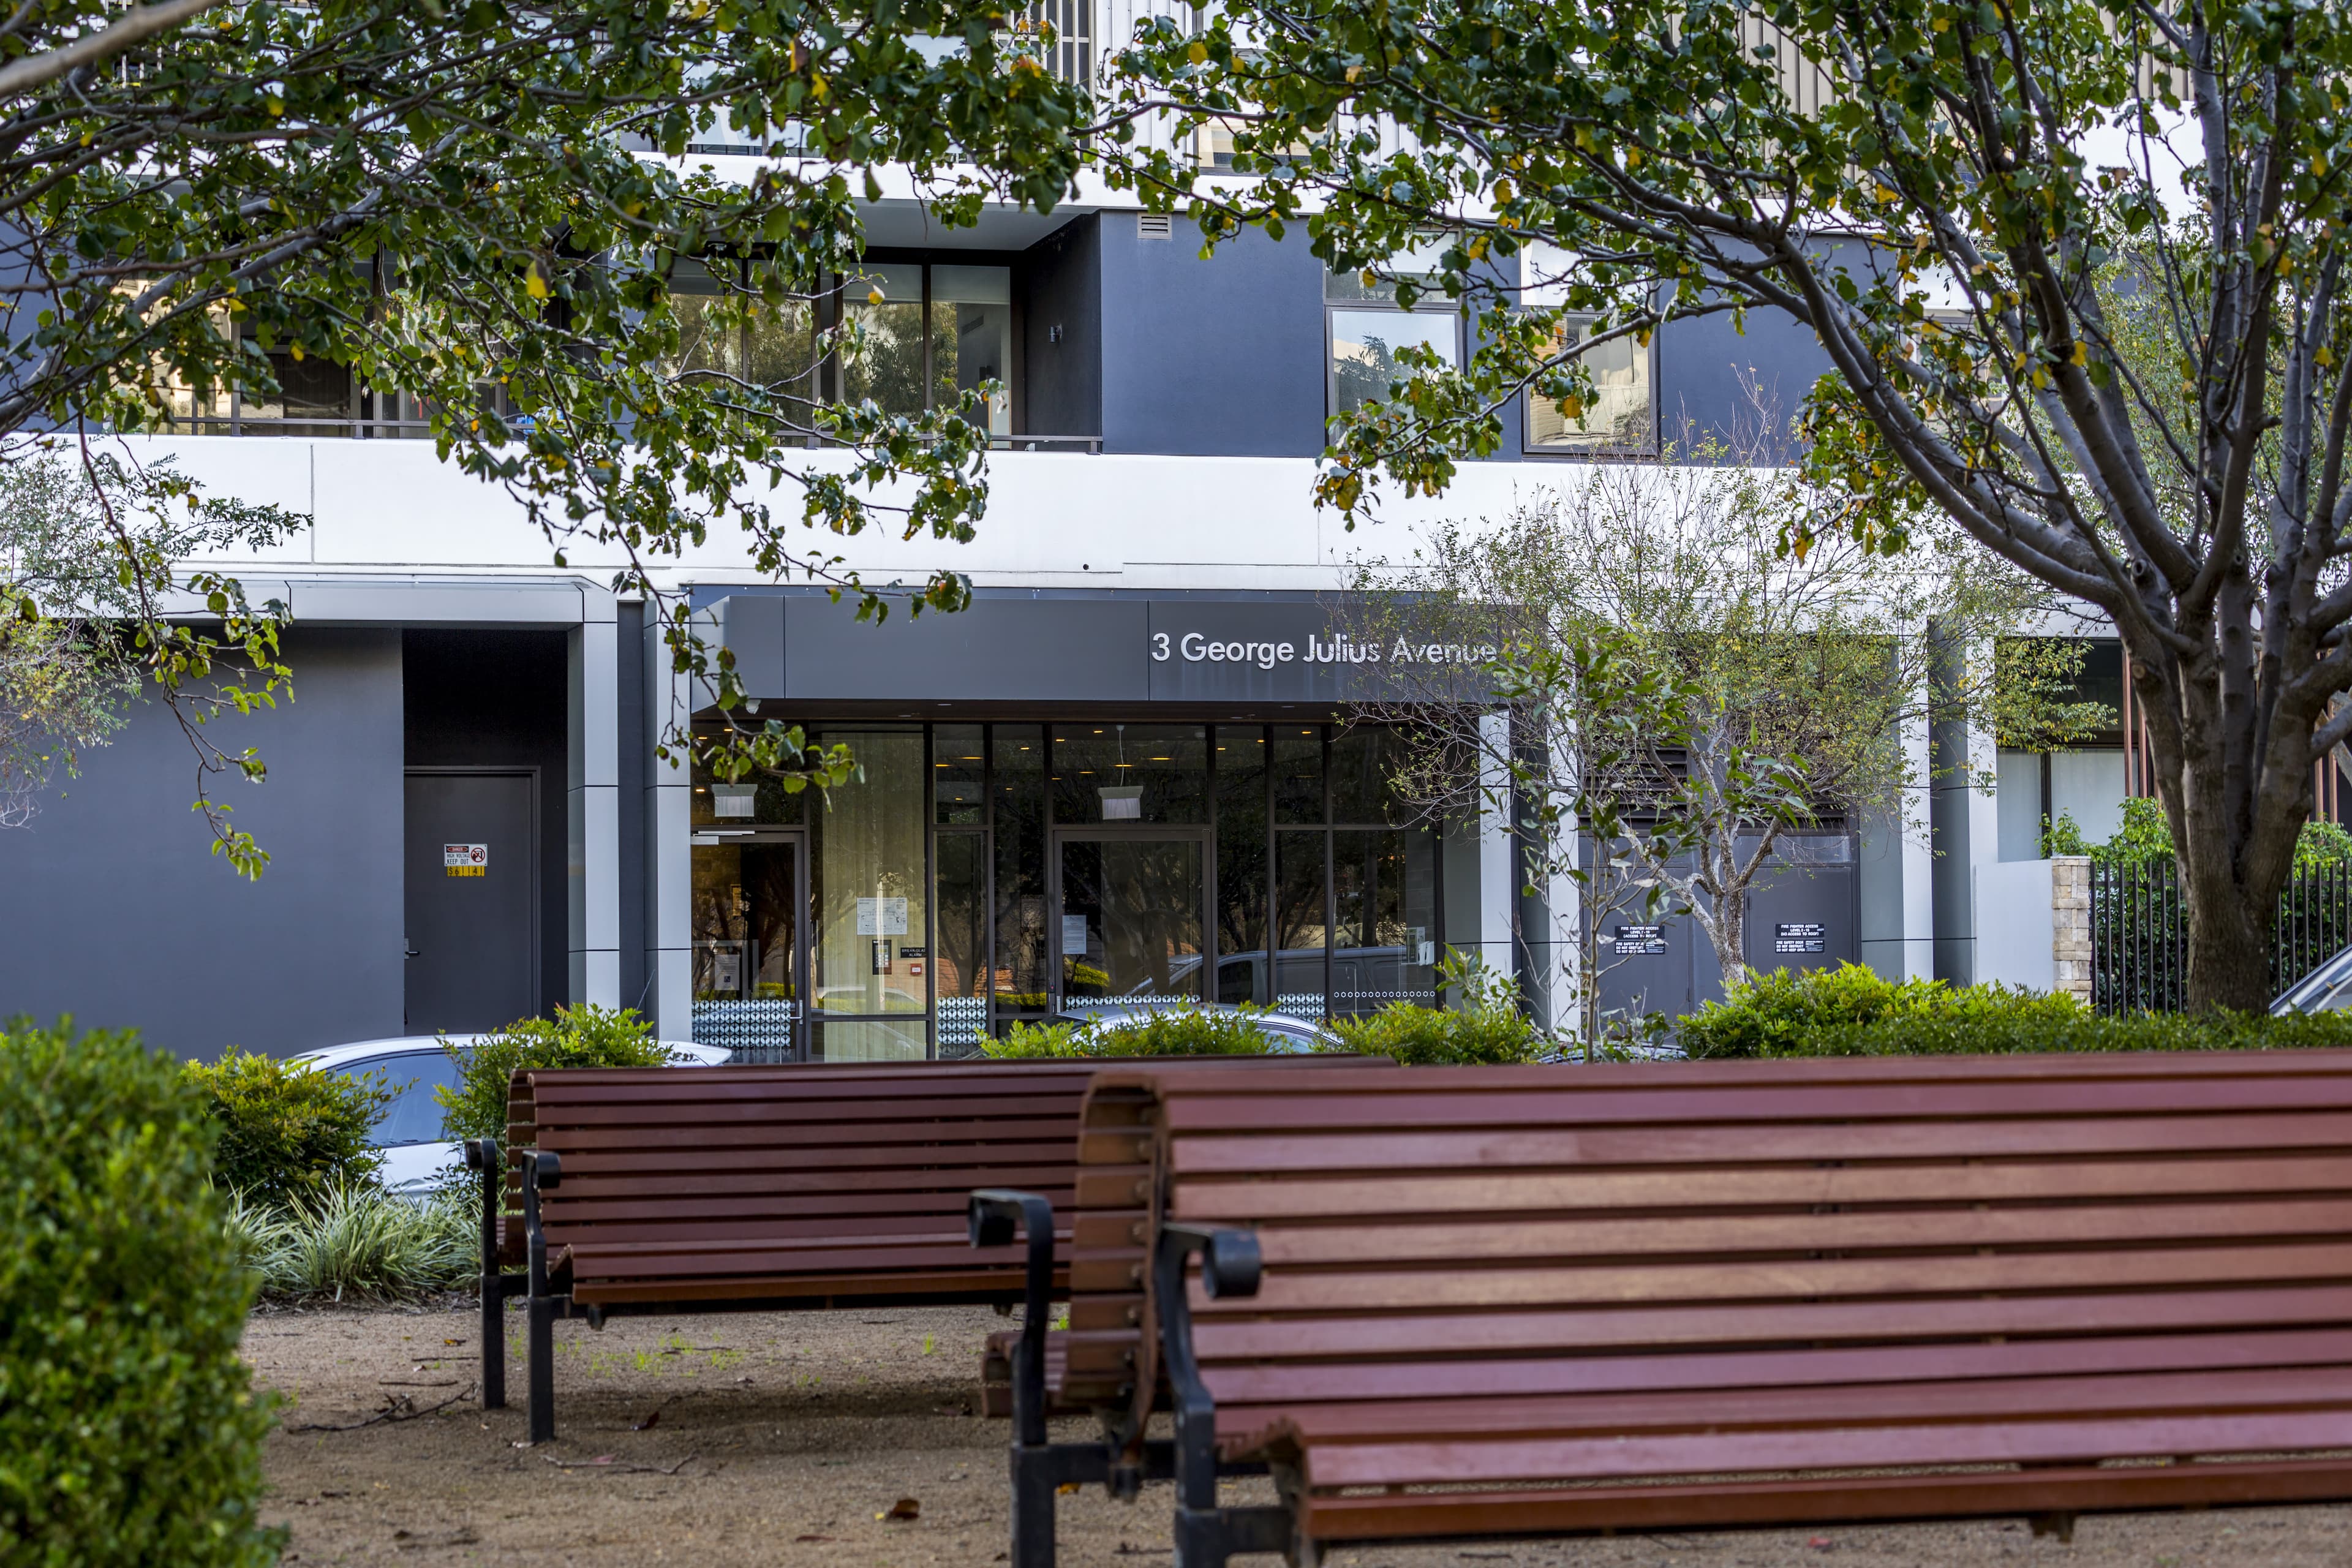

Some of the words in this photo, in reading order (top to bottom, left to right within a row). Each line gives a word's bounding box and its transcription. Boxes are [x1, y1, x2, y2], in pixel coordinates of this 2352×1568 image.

[1152, 633, 1170, 662] 3
[1180, 633, 1294, 669] George
[1303, 633, 1381, 663] Julius
[1389, 635, 1498, 663] Avenue
